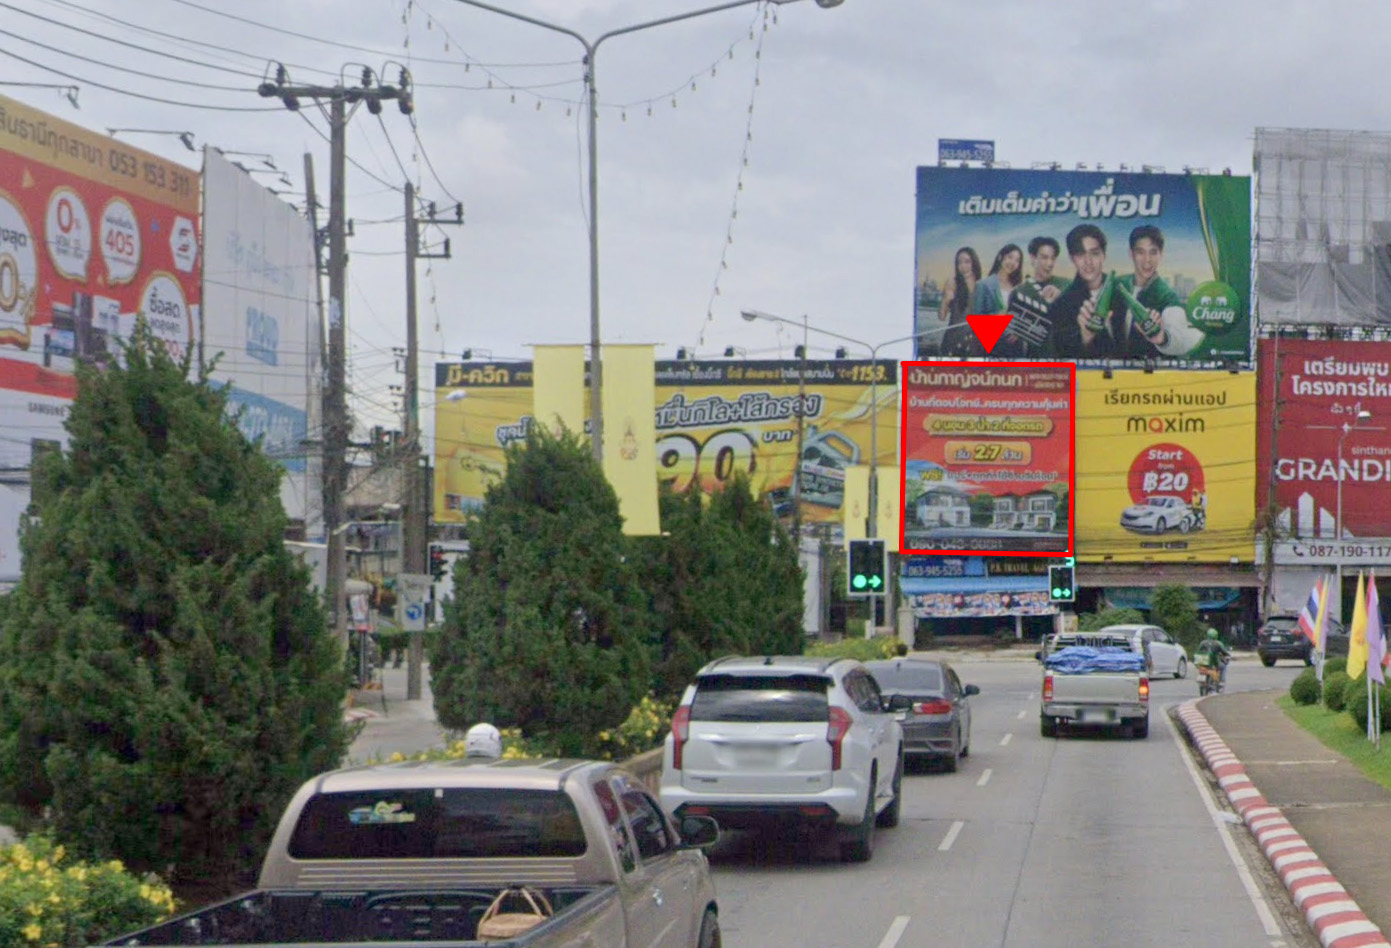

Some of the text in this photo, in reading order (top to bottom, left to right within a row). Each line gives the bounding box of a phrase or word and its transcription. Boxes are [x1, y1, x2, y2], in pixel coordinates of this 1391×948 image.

[1192, 306, 1235, 324] Chang
[1303, 355, 1390, 377] เตรียมพบ
[1104, 389, 1227, 407] เรียกรถผ่านแอป
[1127, 413, 1205, 433] maxim
[974, 444, 1002, 461] 2.7
[1147, 449, 1183, 461] Start
